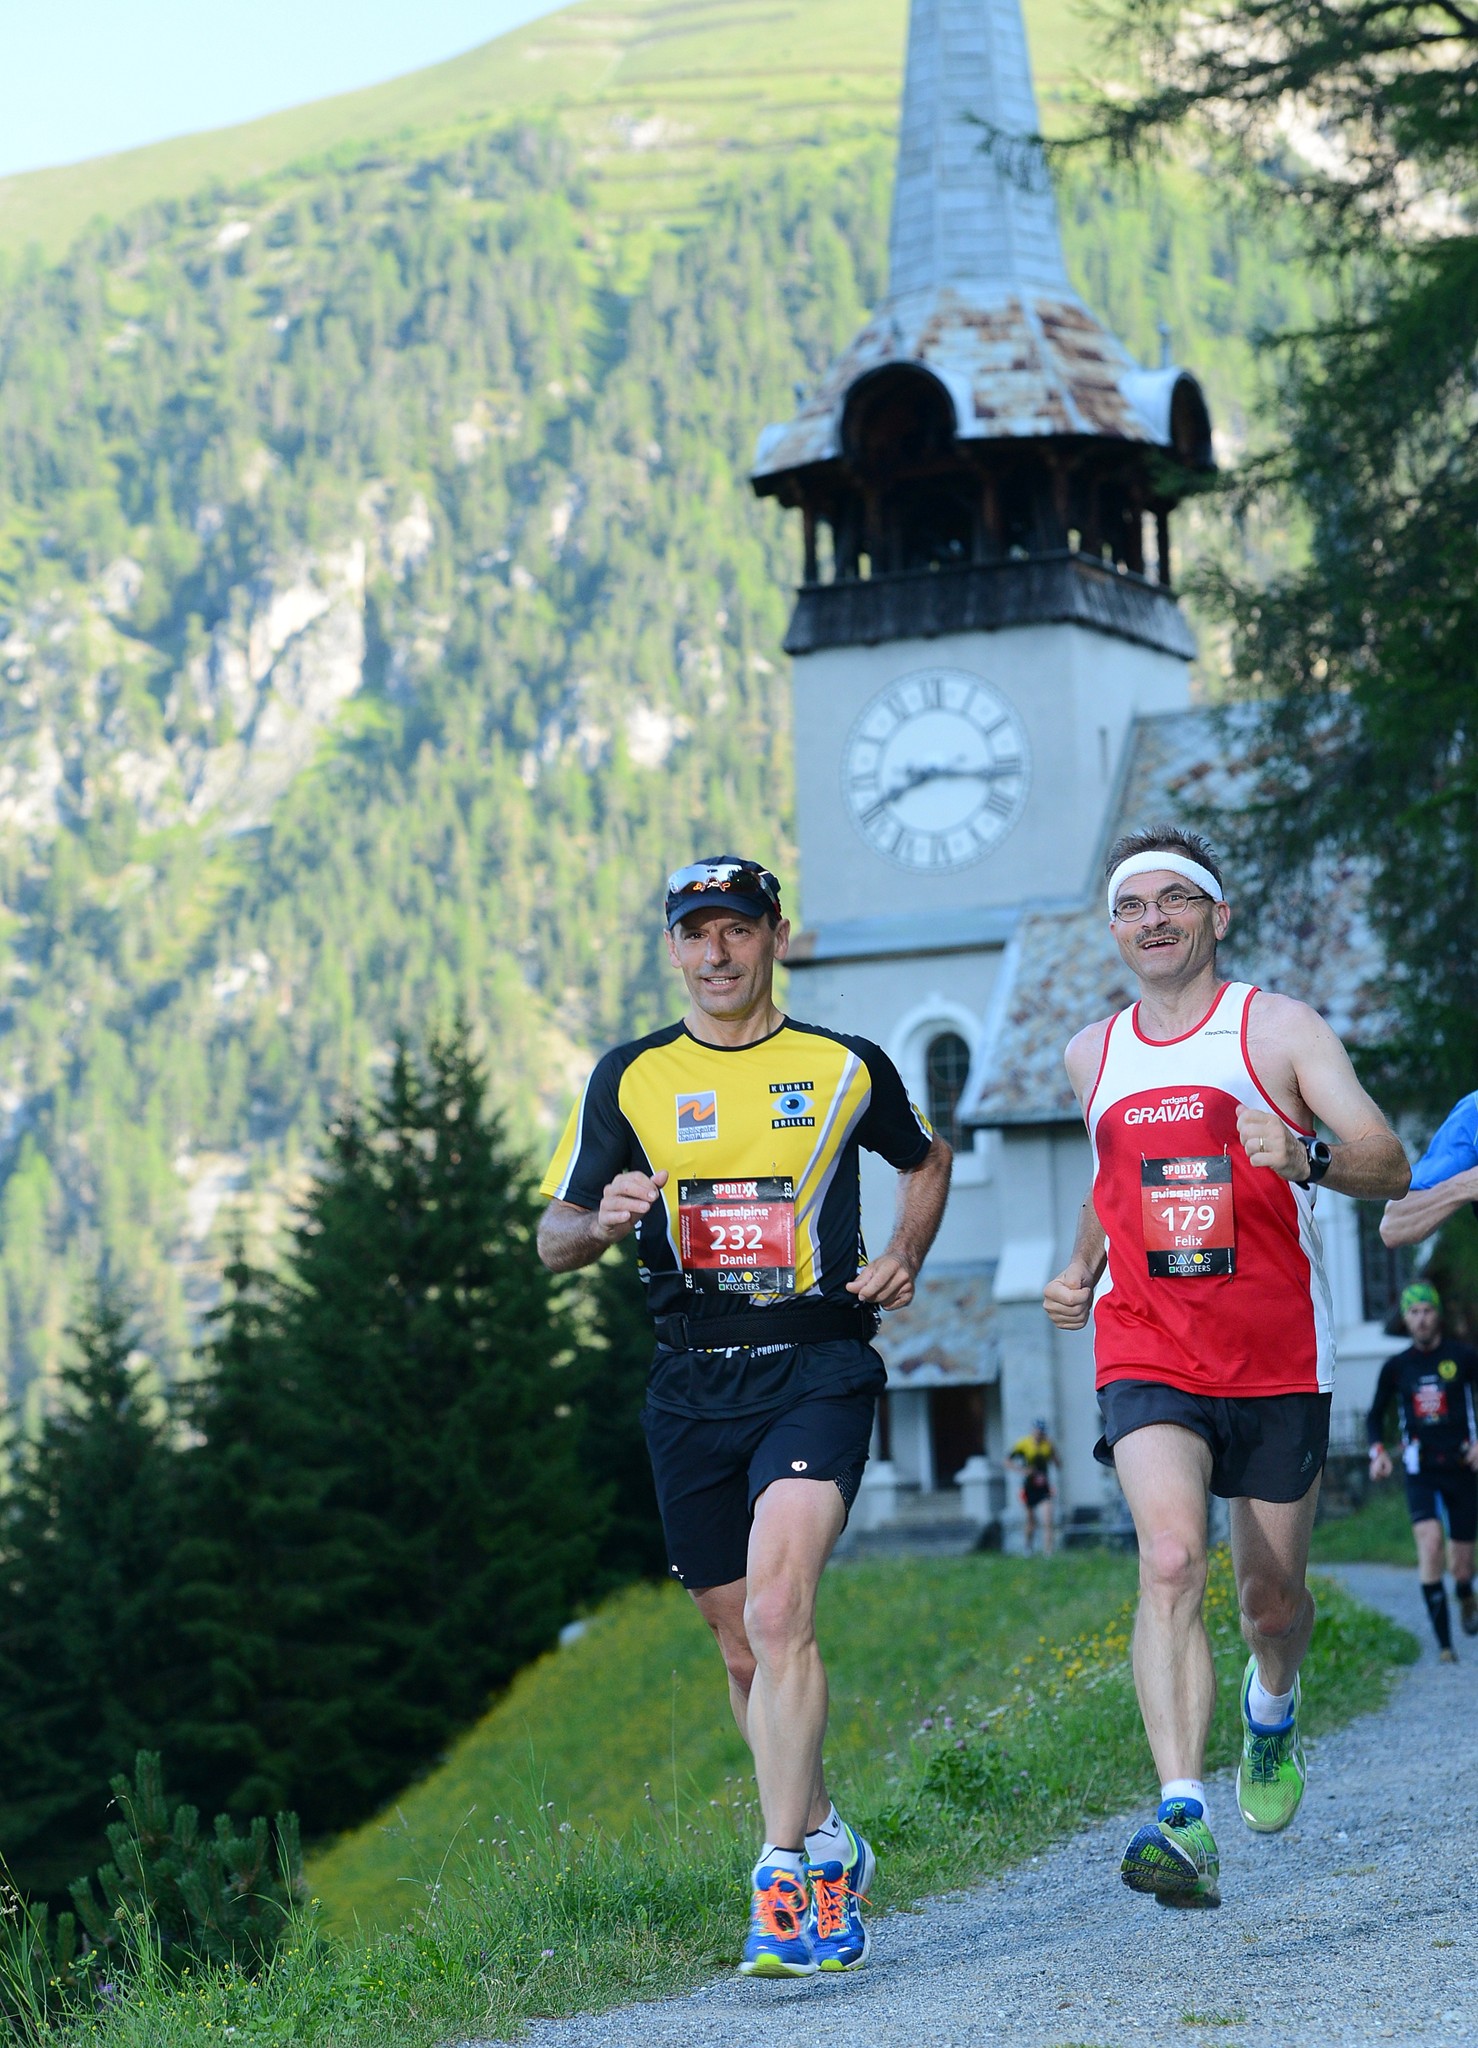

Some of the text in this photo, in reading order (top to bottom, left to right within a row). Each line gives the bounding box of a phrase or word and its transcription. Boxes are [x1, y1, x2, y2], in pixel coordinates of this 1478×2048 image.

[771, 1083, 813, 1092] KÜHNIS
[1161, 1096, 1188, 1105] erdgas
[1124, 1102, 1204, 1125] GRAVAG
[774, 1118, 814, 1128] BRILLEN
[1162, 1162, 1209, 1178] SPORTXX
[712, 1181, 759, 1198] SPORTXX
[784, 1182, 792, 1198] 232
[1151, 1187, 1219, 1200] swissalpine
[701, 1206, 769, 1219] swissalpine
[1161, 1205, 1215, 1231] 179
[709, 1225, 763, 1250] 232
[1175, 1236, 1202, 1246] Felix
[720, 1253, 757, 1265] Daniel
[1168, 1253, 1211, 1265] DAVOS
[1176, 1265, 1211, 1273] KLOSTERS
[684, 1274, 692, 1289] 232
[718, 1272, 761, 1283] DAVOS
[725, 1283, 760, 1291] KLOSTERS
